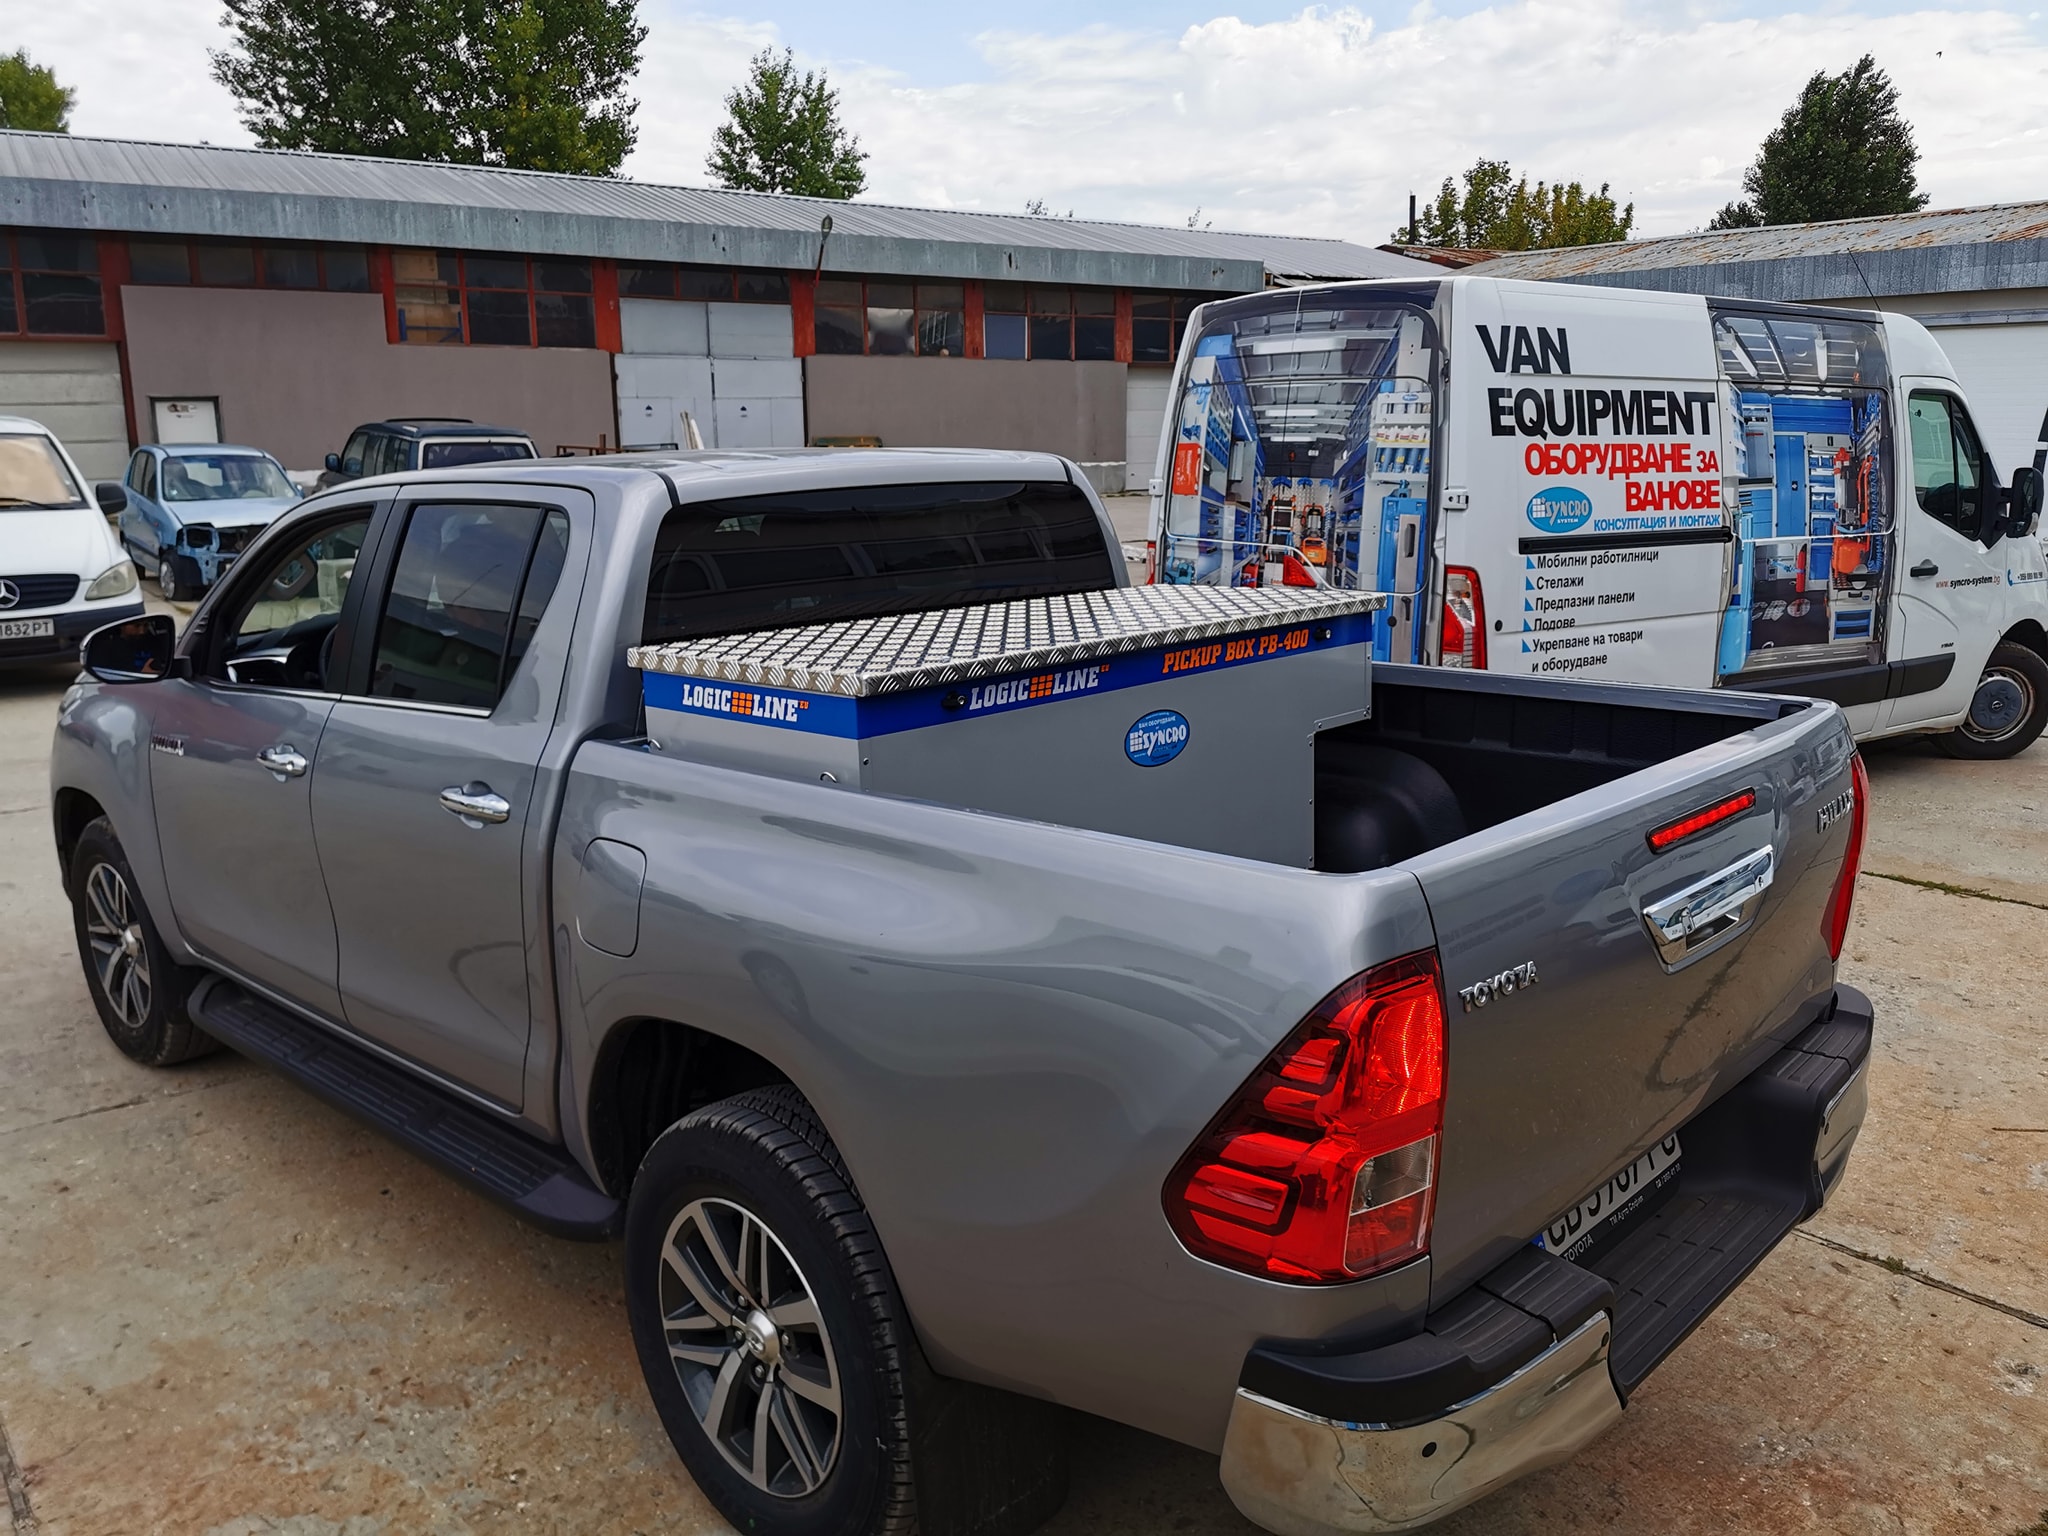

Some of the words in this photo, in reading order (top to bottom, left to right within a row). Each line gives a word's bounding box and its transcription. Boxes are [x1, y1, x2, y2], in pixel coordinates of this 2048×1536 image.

[1475, 324, 1571, 375] VAN
[1487, 387, 1716, 441] EQUIPMENT
[1524, 442, 1692, 480] ОБОРУДВАНЕ
[1696, 450, 1720, 473] ЗА
[1625, 479, 1721, 512] ВАНОВЕ
[1544, 498, 1589, 526] SYNCRO
[1594, 516, 1667, 532] КОНСУЛТАЦИЯ
[1669, 517, 1676, 527] И
[1678, 514, 1721, 527] МОНТАЖ
[1537, 553, 1588, 569] Мобилни
[1590, 550, 1660, 566] работилници
[1536, 574, 1584, 590] Стелажи
[1535, 595, 1595, 612] Предпазни
[1597, 590, 1635, 605] панели
[1533, 616, 1576, 632] Подове
[1162, 646, 1222, 674] PICKUP
[1225, 637, 1256, 660] BOX
[1258, 629, 1310, 656] PB-400
[1532, 633, 1590, 652] Укрепване
[1592, 635, 1606, 646] на
[1608, 630, 1643, 646] товари
[1531, 662, 1538, 672] и
[1542, 653, 1608, 672] оборудване
[682, 683, 732, 713] LOGIC
[751, 693, 799, 722] LINE
[969, 678, 1030, 711] LOGIC
[1052, 666, 1101, 695] LINE
[1142, 724, 1187, 757] SYNCRO
[1458, 960, 1539, 1013] TOYOTA
[1564, 1233, 1594, 1262] TOYOTA
